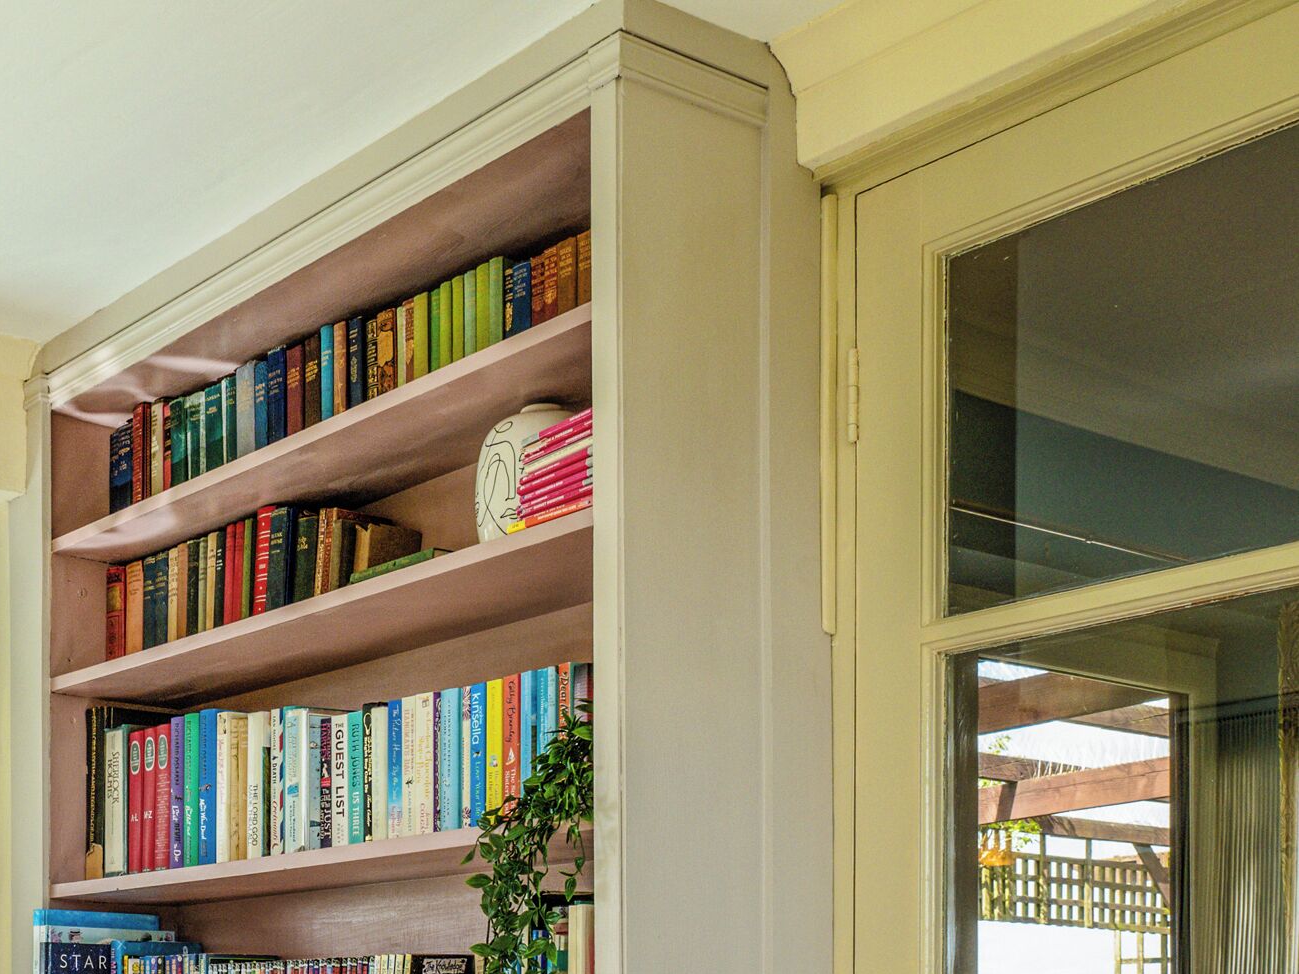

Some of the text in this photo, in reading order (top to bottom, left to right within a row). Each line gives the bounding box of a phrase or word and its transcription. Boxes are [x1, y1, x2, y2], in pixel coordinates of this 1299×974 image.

[559, 671, 570, 702] Dear
[471, 692, 481, 745] kinsella
[111, 751, 120, 805] SHERLOCK
[335, 729, 345, 780] GUEST
[351, 723, 360, 837] RUTH JONES US THREE
[324, 808, 332, 839] JUST
[335, 785, 345, 818] LIST
